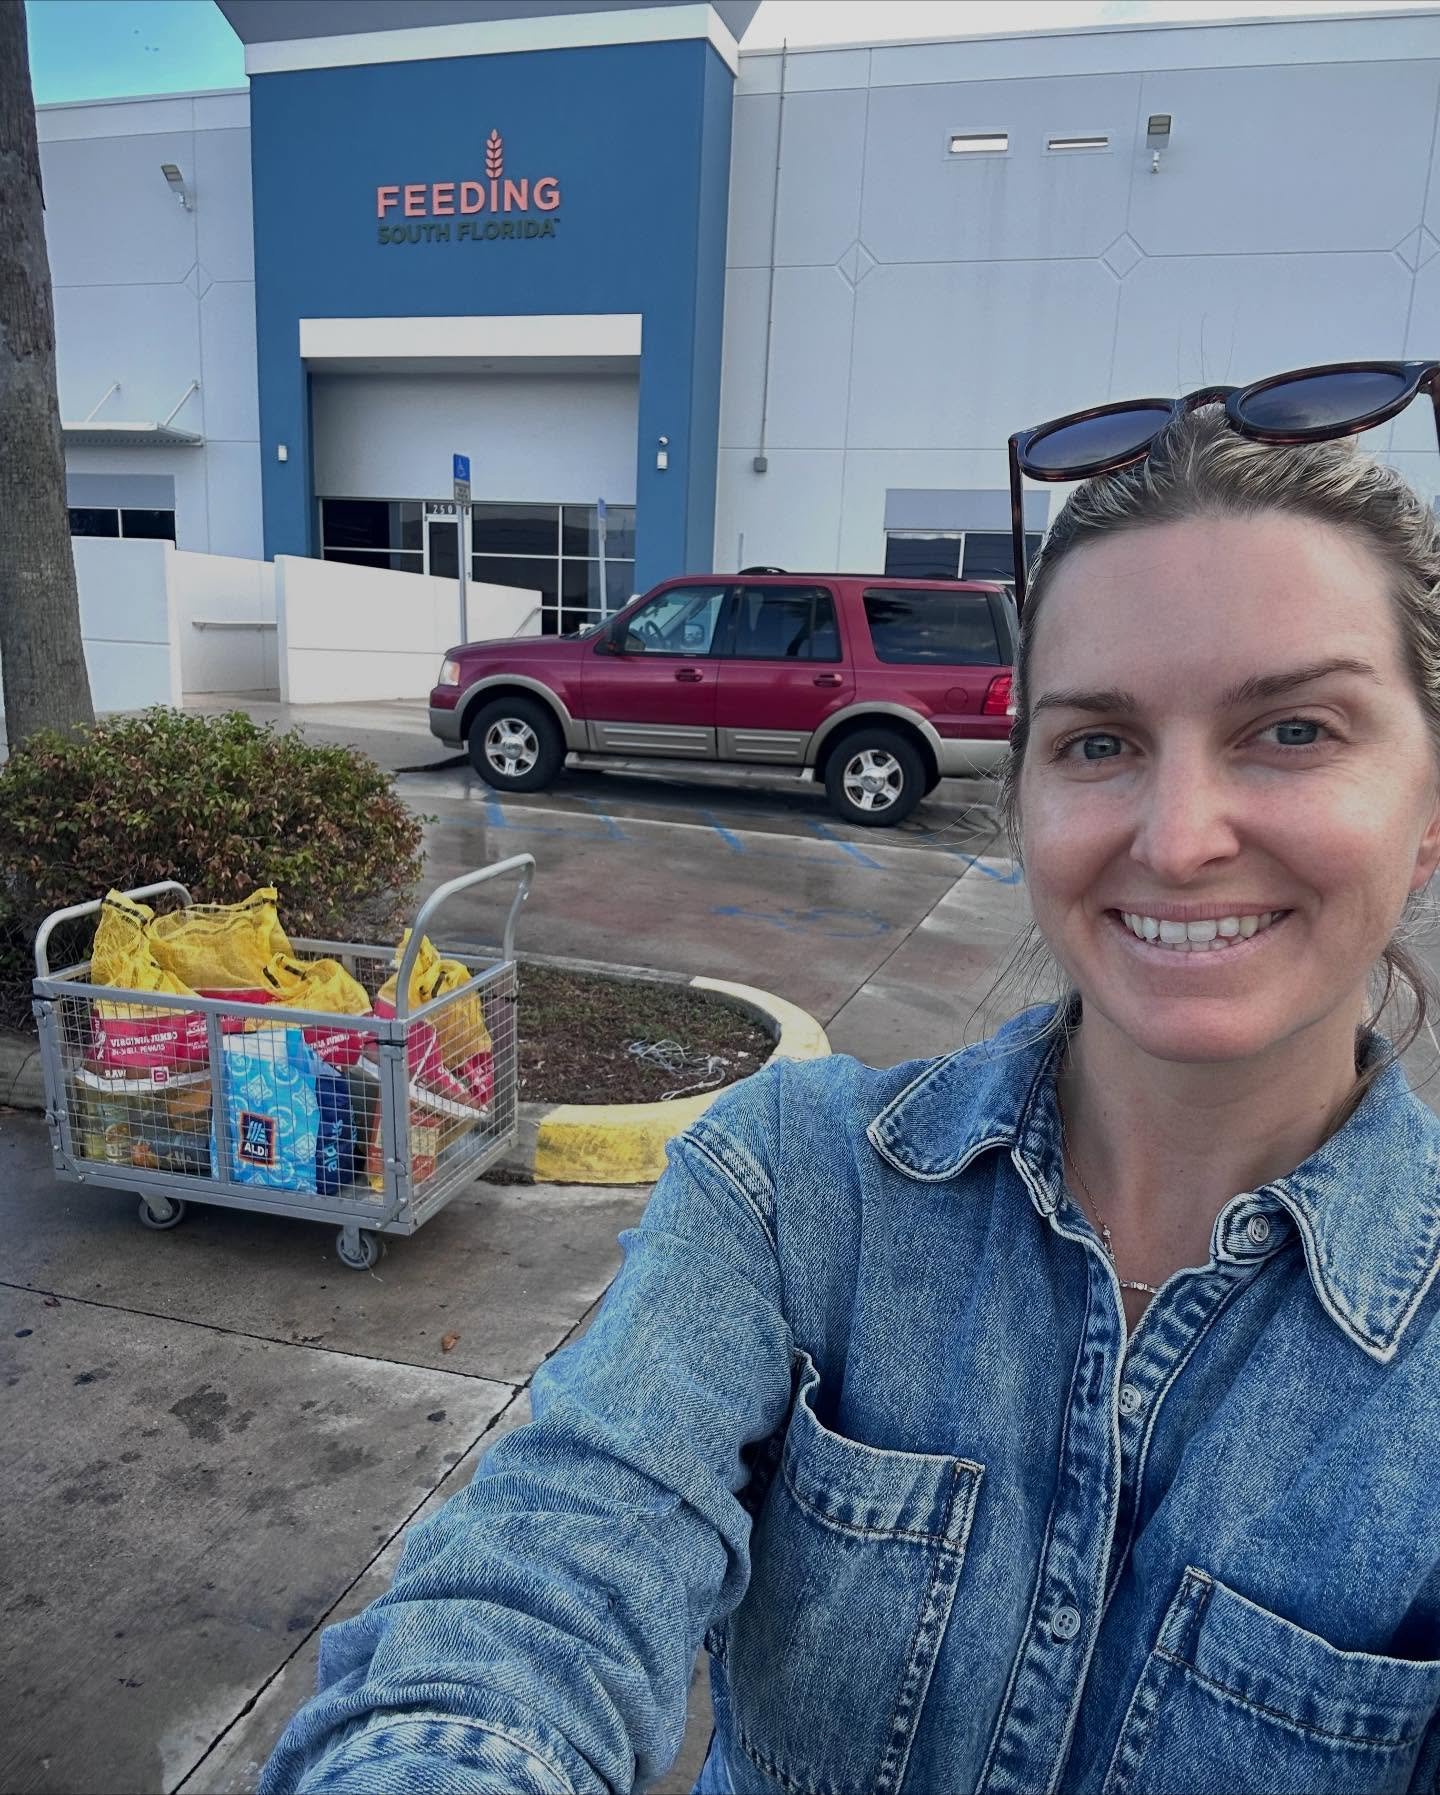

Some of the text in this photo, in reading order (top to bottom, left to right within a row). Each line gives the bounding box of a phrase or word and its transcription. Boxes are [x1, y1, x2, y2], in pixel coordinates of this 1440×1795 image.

[377, 177, 560, 218] FEEDING
[378, 221, 450, 245] SOUTH
[110, 1031, 178, 1048] VIRGINIA JUMBO
[244, 1143, 269, 1157] ALDI
